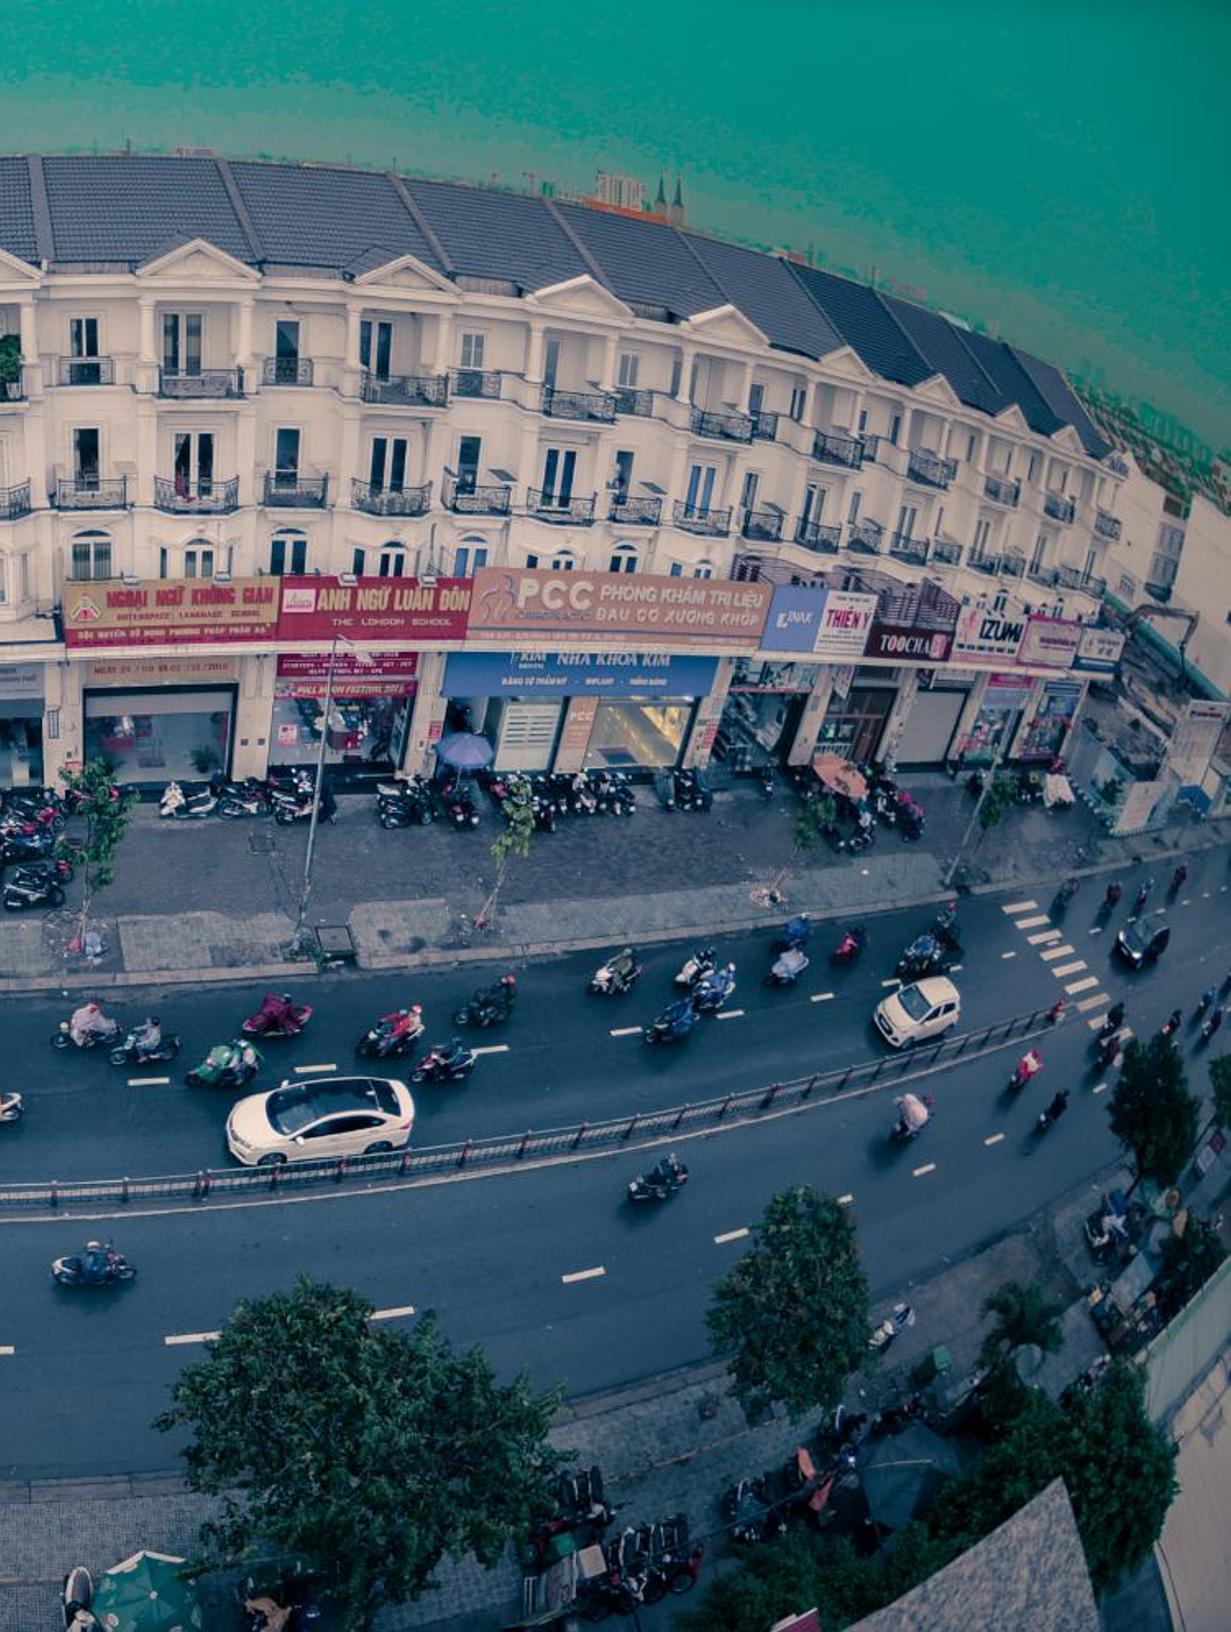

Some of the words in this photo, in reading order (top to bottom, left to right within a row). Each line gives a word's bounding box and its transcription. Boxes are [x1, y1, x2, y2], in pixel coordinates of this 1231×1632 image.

[318, 588, 351, 611] ANH
[356, 586, 392, 611] NGỮ
[517, 577, 595, 610] PCC
[332, 618, 355, 626] THE
[361, 618, 405, 626] LONDON
[412, 618, 452, 626] SCHOOL
[979, 619, 1024, 643] IZUMI
[880, 634, 930, 654] TOOCHA
[642, 653, 671, 667] KIM
